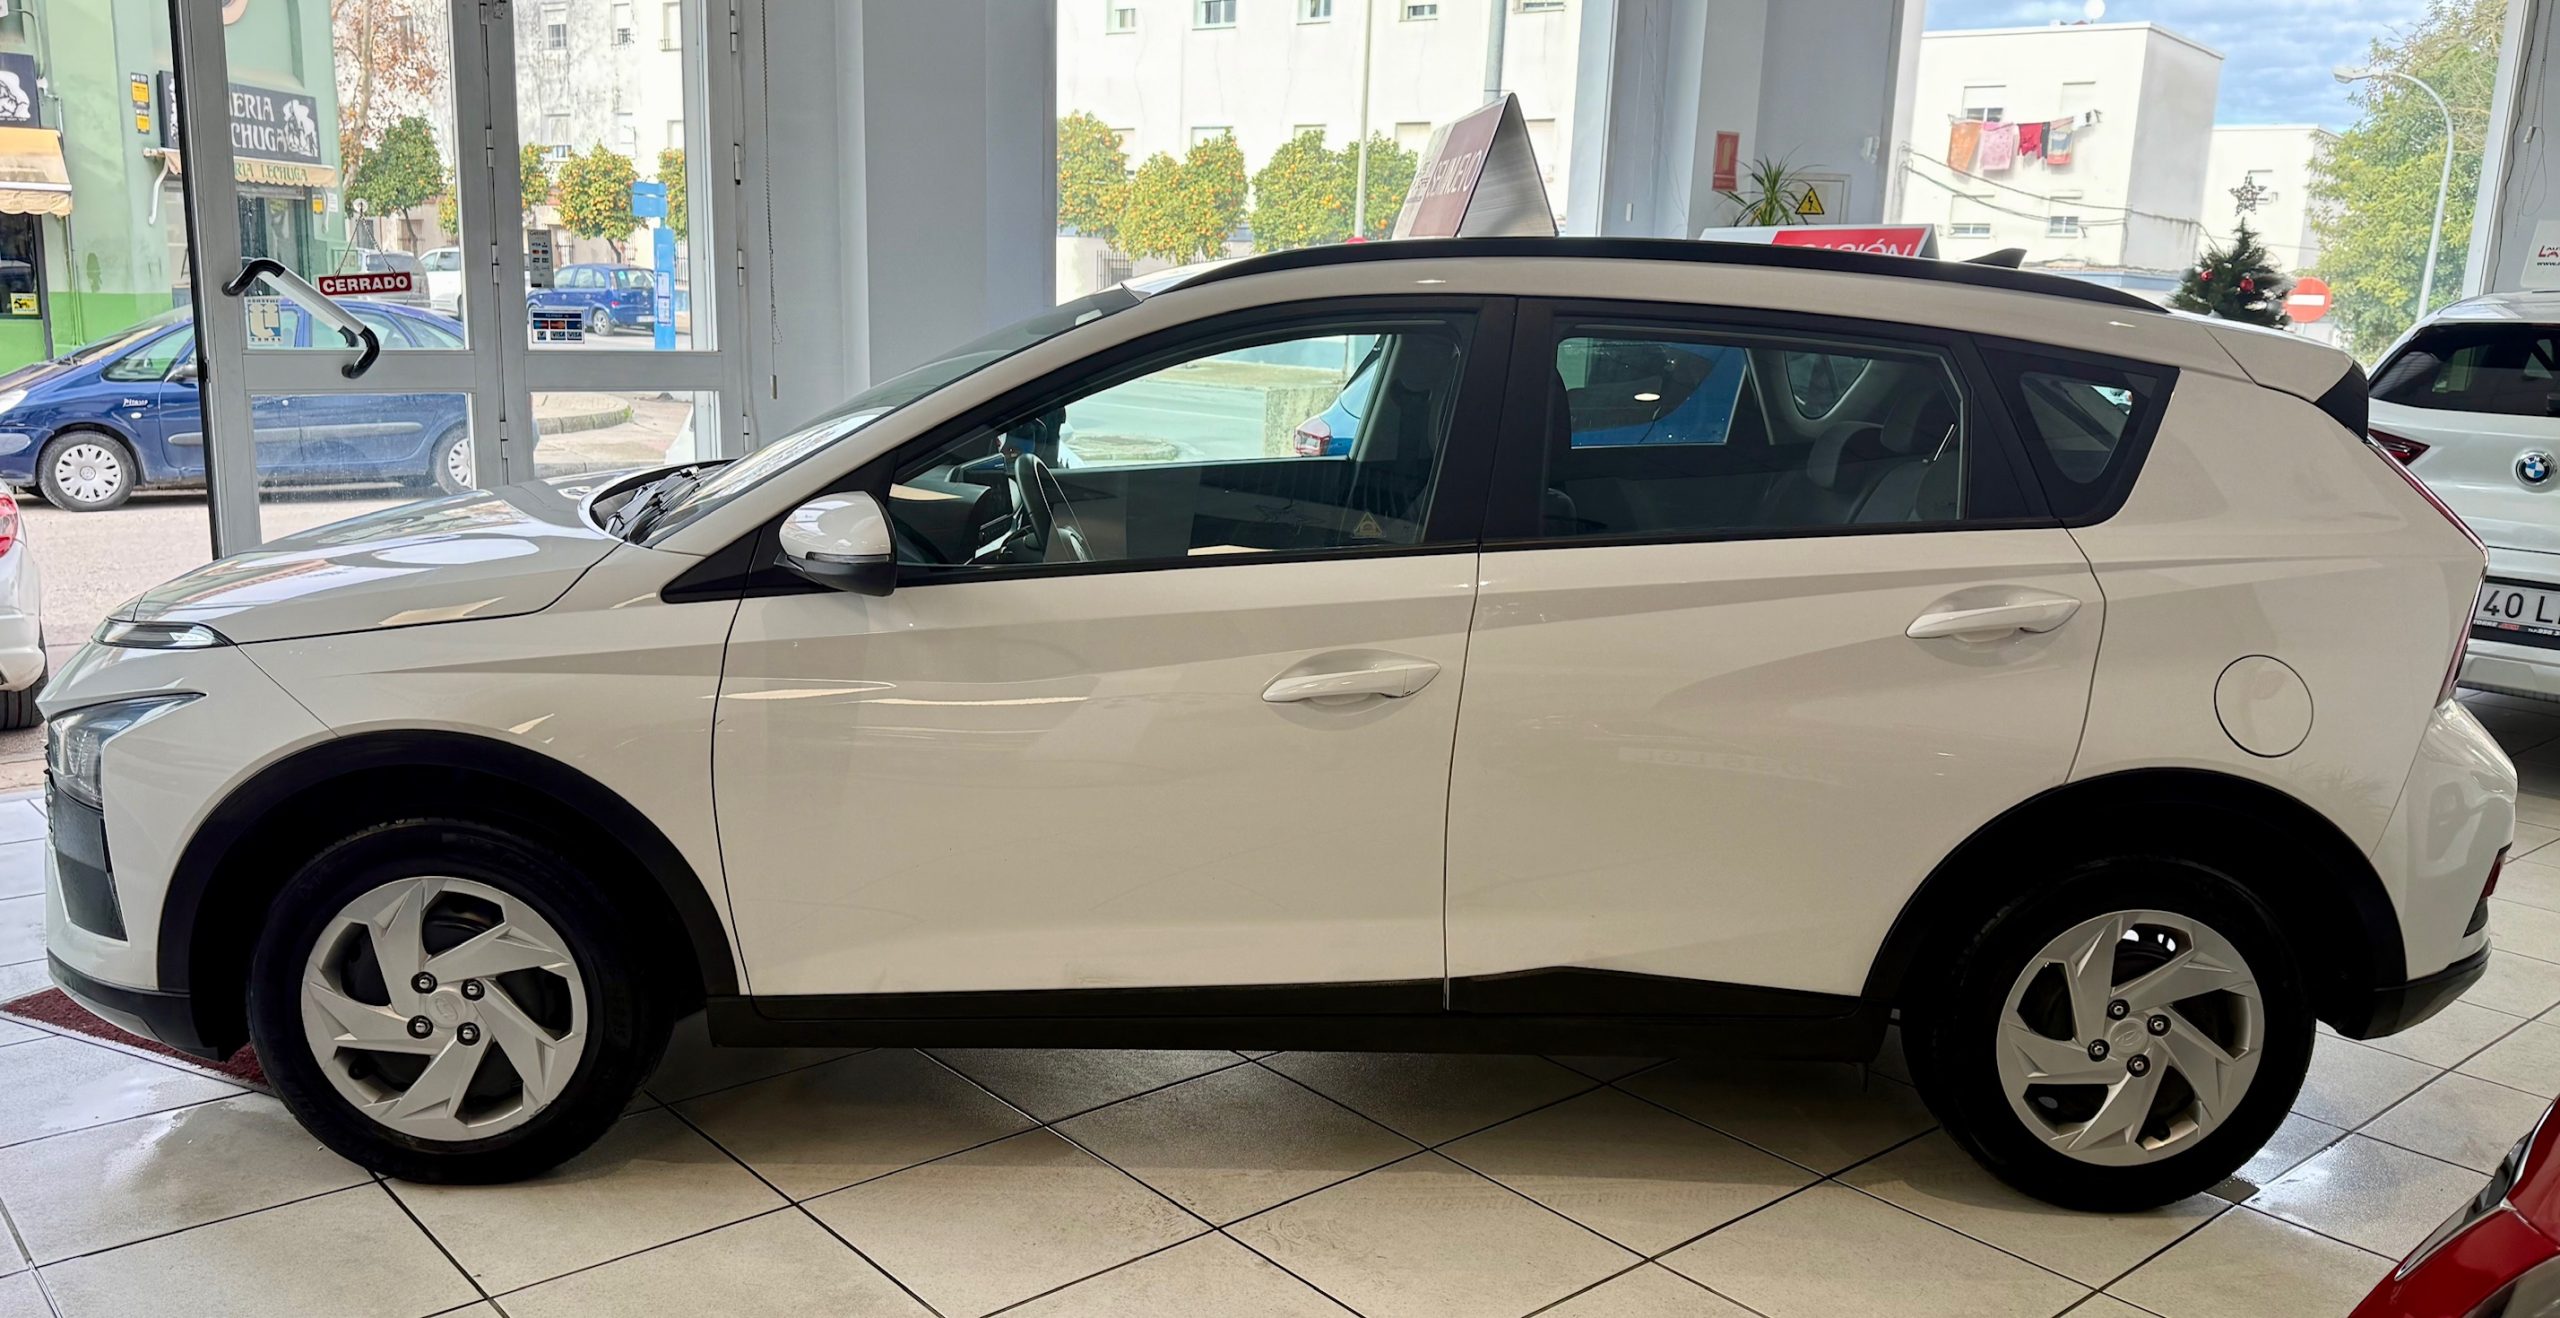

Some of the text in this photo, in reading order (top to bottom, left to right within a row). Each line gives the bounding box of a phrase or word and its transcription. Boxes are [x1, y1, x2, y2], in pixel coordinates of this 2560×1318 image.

[322, 276, 408, 293] CERRADO
[2483, 590, 2560, 625] 40 L
